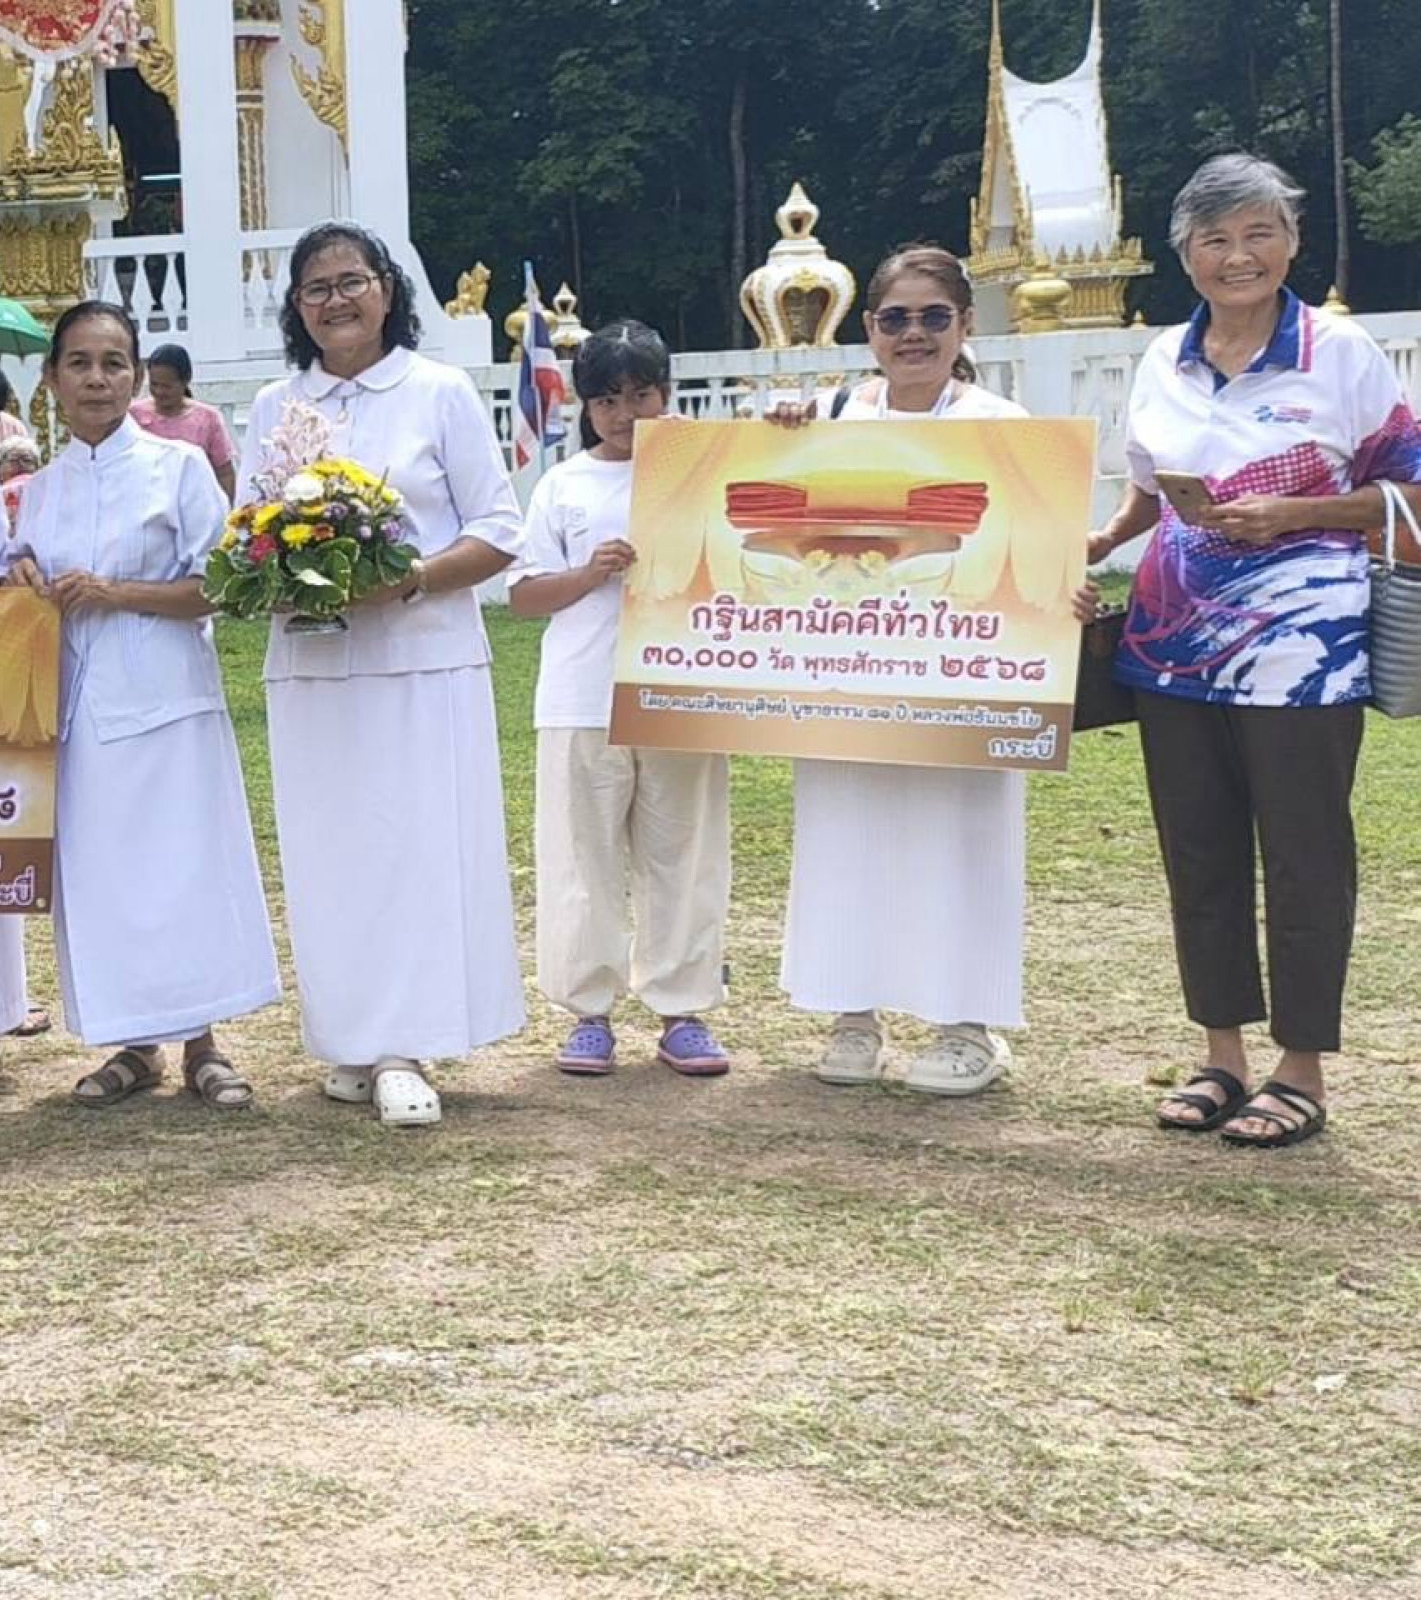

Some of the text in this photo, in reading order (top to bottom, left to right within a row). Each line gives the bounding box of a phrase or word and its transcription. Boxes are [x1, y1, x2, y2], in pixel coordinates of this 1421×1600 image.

[691, 590, 999, 642] กฐินสามัคคีทั่วไทย
[642, 646, 1047, 681] ๓๐,๐๐๐ วัด พุทธศักราช ๒๕๖๘
[991, 726, 1055, 758] กระบี่
